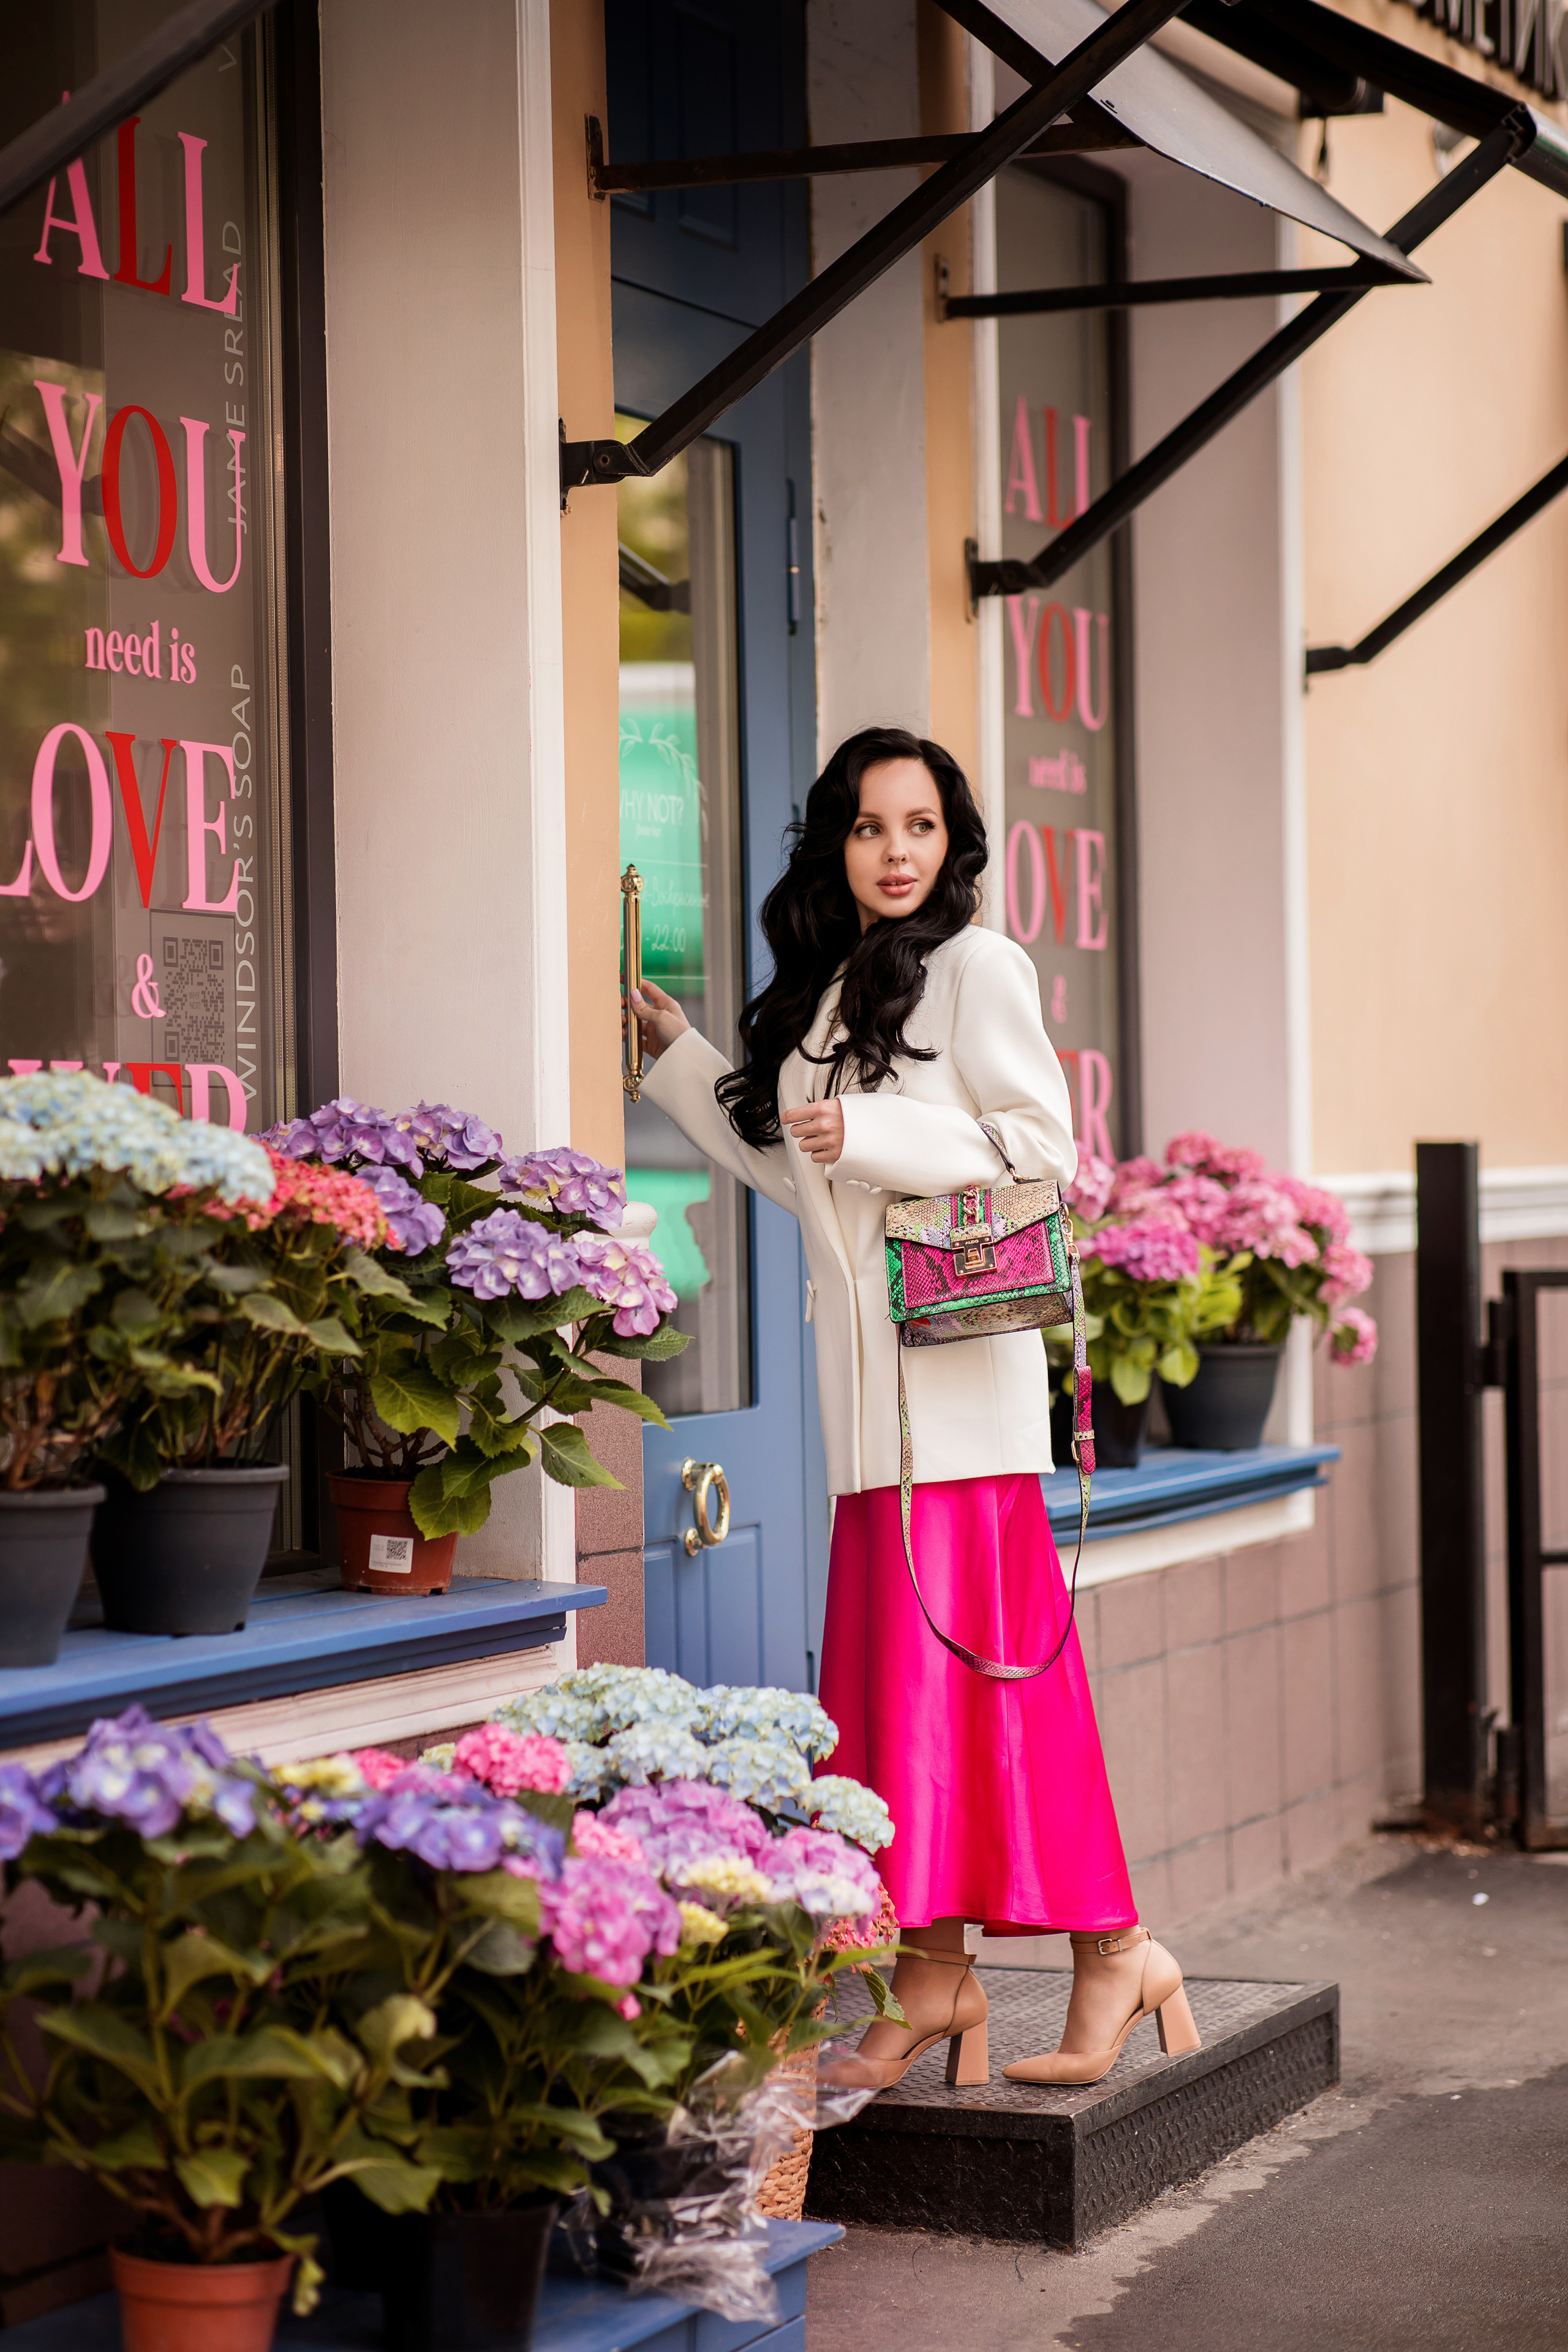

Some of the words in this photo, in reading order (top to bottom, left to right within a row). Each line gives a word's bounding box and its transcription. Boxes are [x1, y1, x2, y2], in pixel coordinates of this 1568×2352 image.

[34, 91, 238, 315] ALL
[34, 380, 246, 593] YOU
[85, 620, 160, 679] need
[170, 628, 197, 684] is
[1006, 595, 1109, 731] YOU
[231, 664, 252, 799] SOAP
[647, 793, 685, 826] NOT?
[1006, 820, 1109, 950] OVE
[132, 954, 167, 1019] &
[233, 815, 257, 1101] WINDSOR'S
